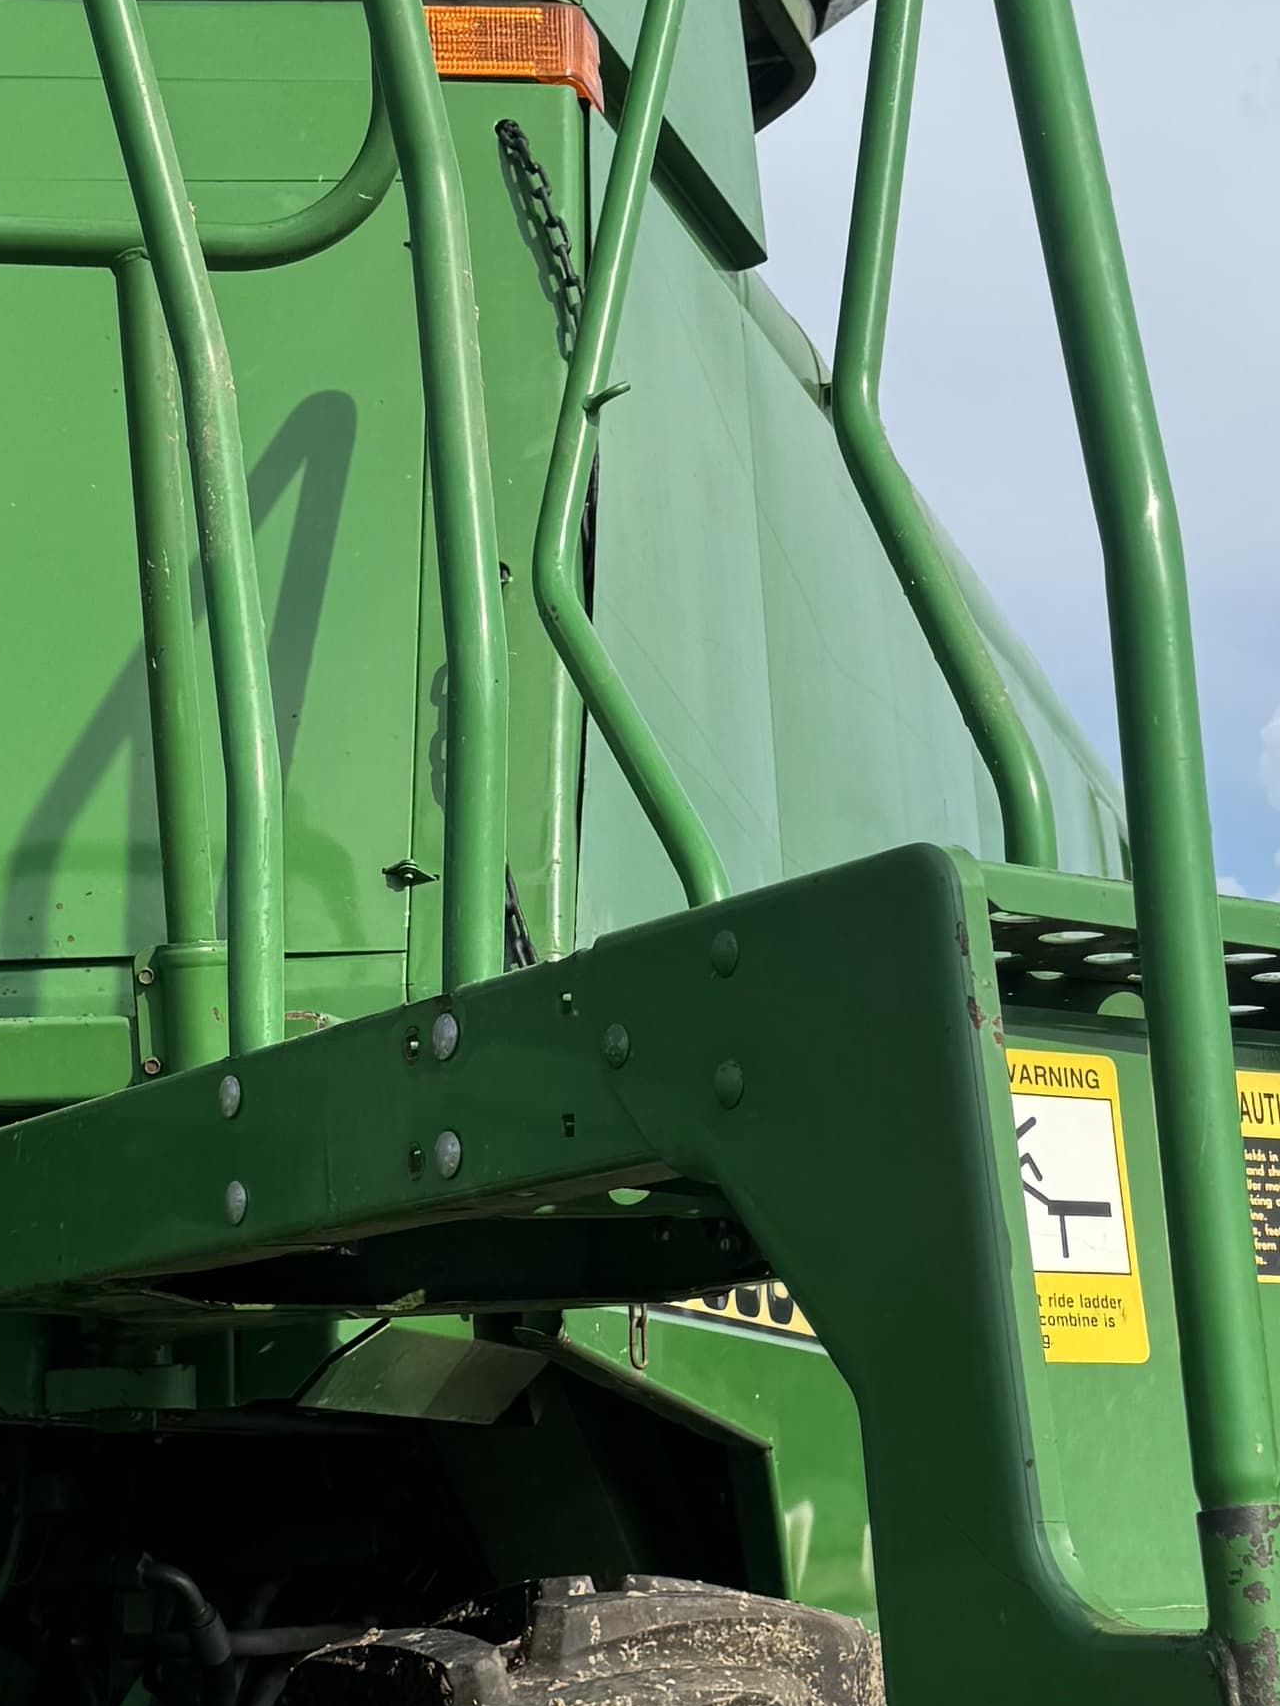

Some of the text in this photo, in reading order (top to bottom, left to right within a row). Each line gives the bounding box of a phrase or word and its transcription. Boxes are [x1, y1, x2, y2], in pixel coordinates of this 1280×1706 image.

[1048, 1293, 1074, 1308] ride
[1080, 1293, 1122, 1309] ladder
[1040, 1312, 1116, 1328] combine is
